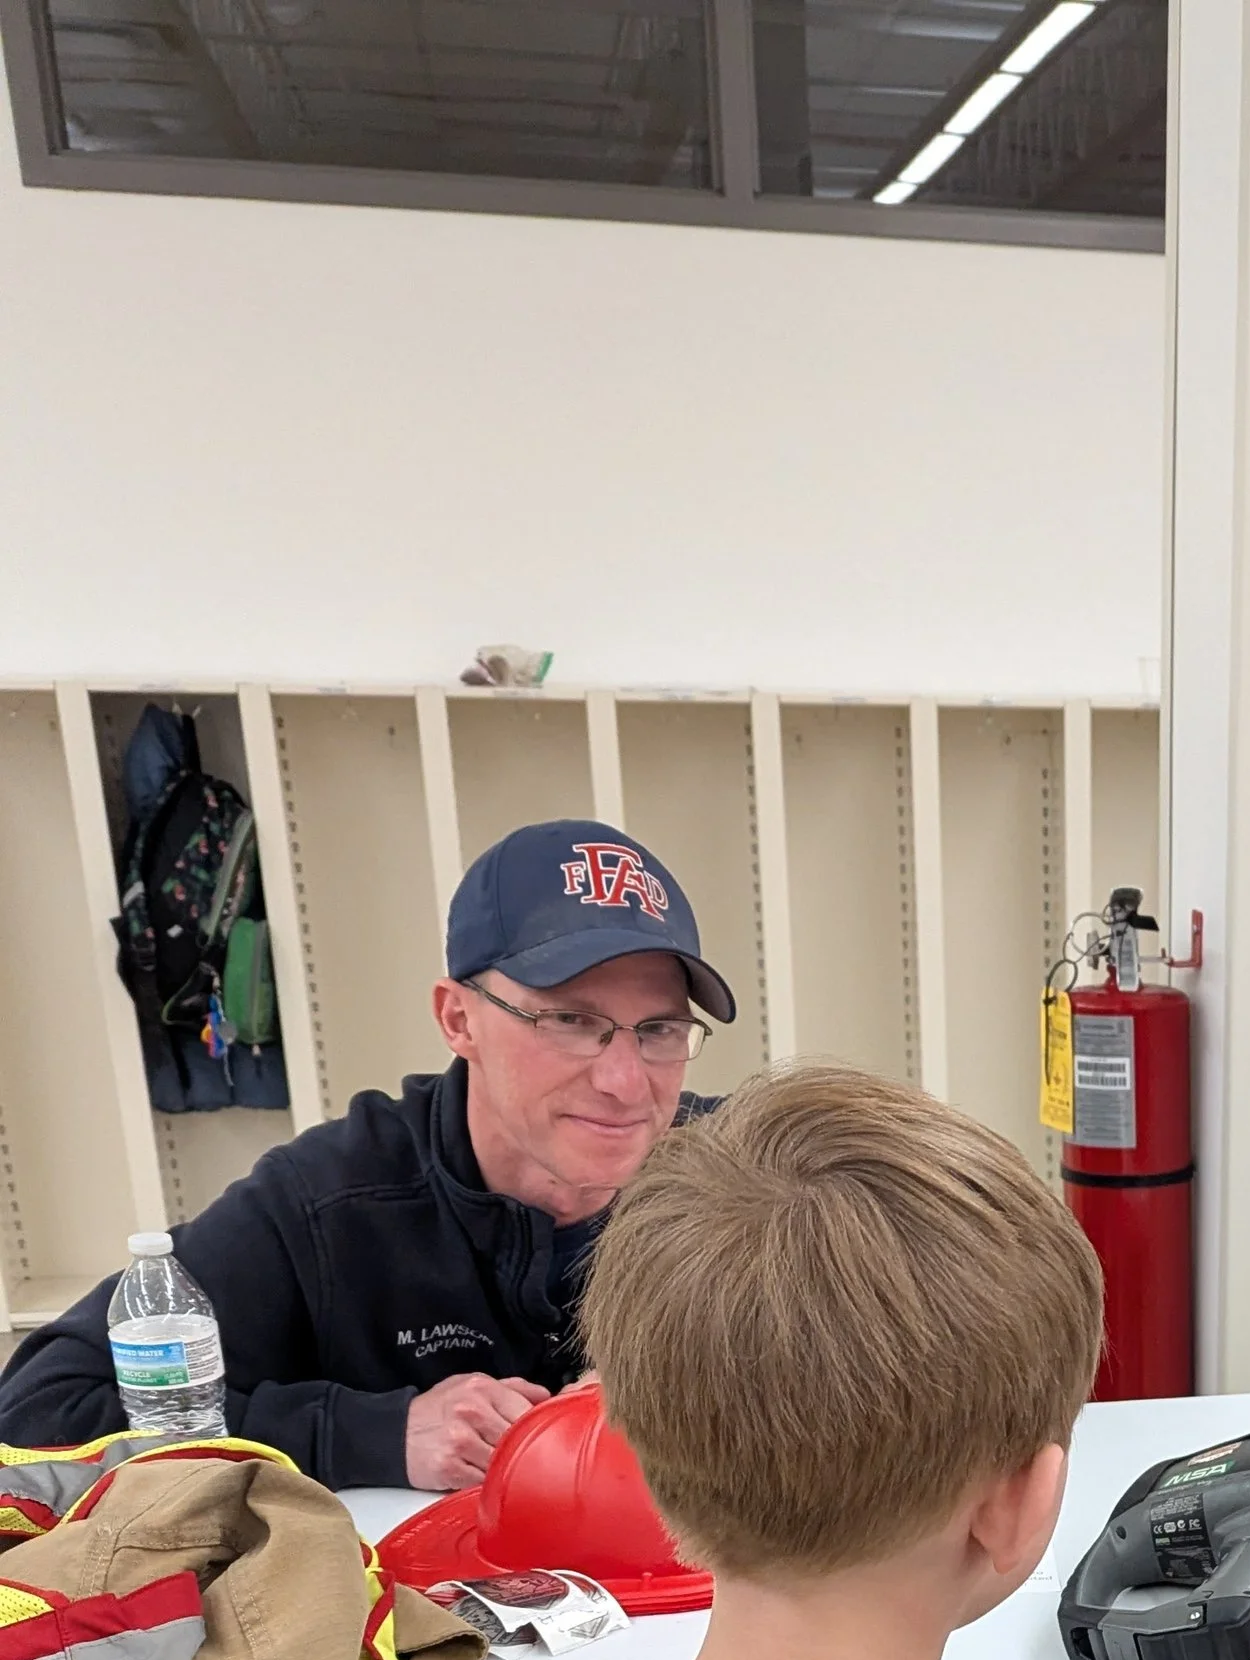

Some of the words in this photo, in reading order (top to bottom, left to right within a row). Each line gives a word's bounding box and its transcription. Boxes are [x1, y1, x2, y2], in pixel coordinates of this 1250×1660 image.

[397, 1330, 415, 1345] M.
[138, 1349, 164, 1357] WATER
[415, 1338, 475, 1357] CAPTAIN
[1163, 1462, 1227, 1487] MSA
